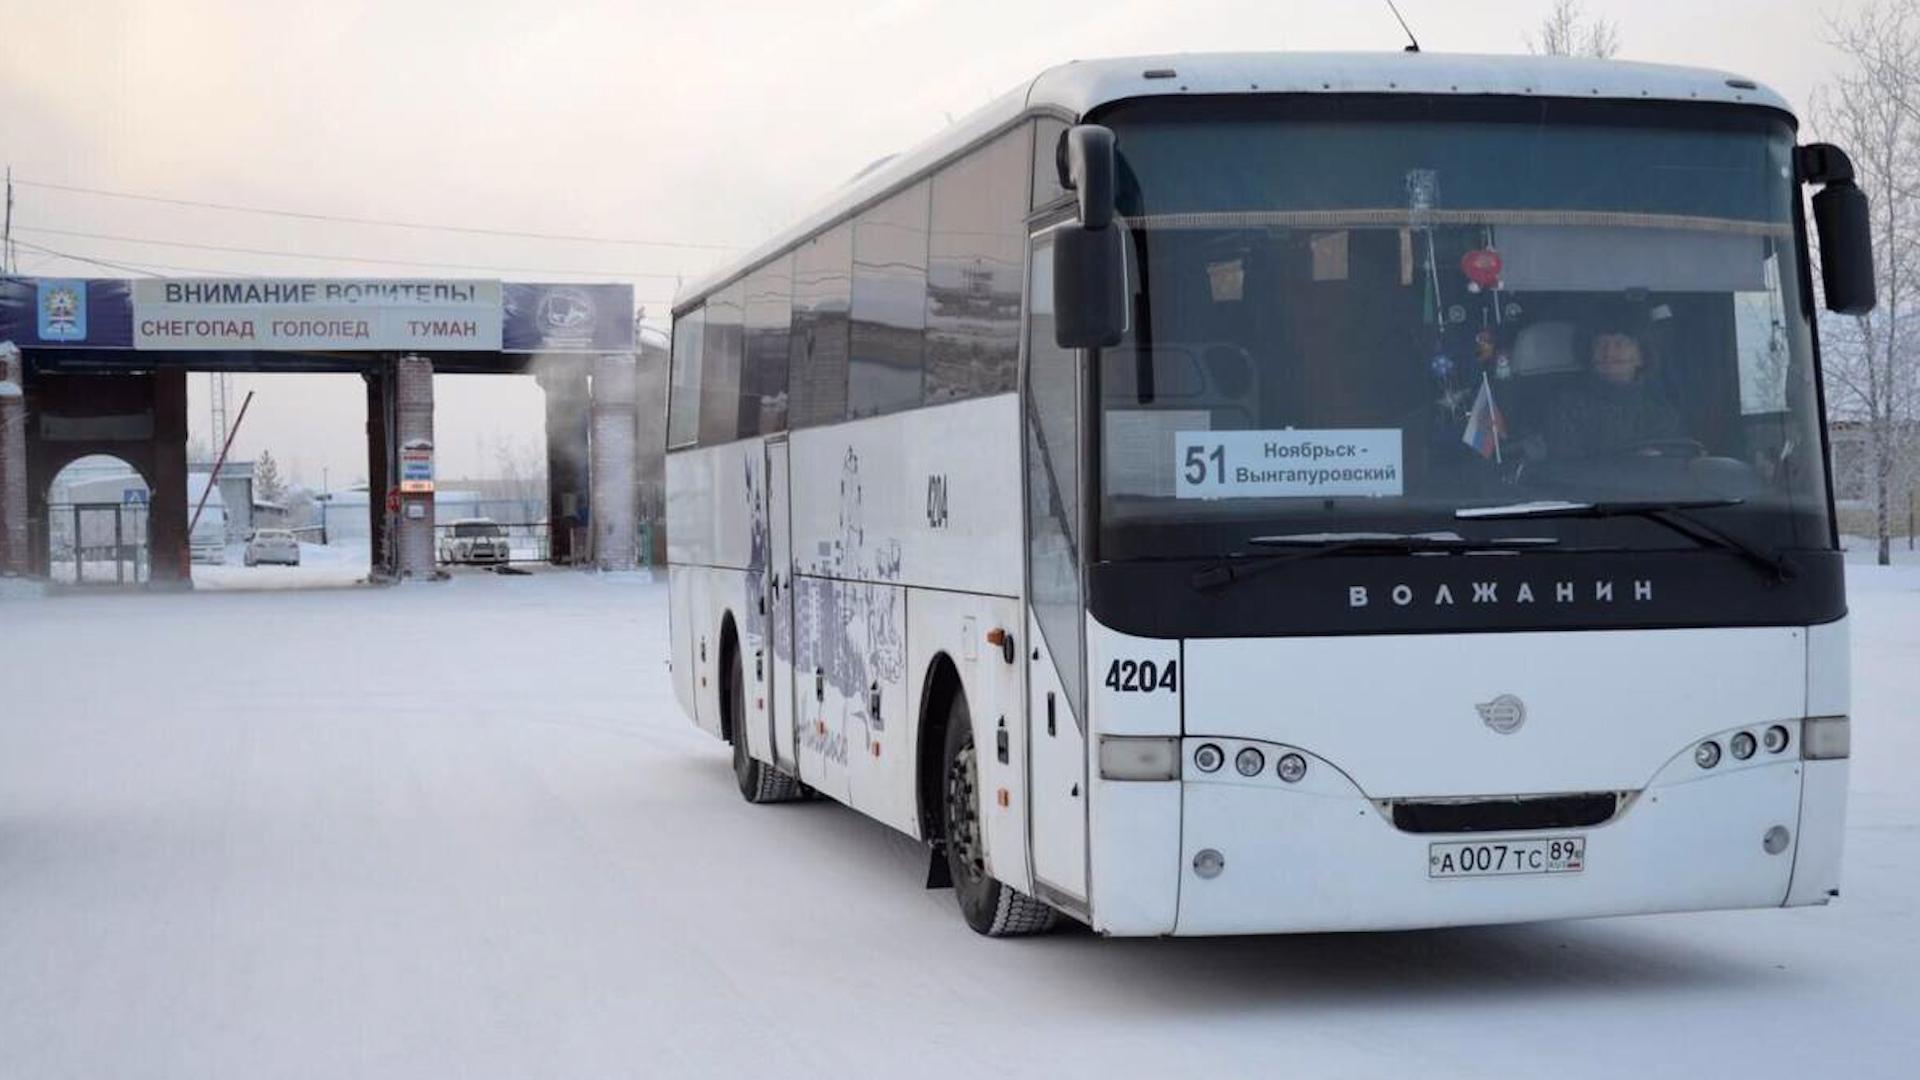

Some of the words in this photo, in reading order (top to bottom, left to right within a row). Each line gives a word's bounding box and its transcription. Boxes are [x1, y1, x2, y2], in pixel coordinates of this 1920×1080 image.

[165, 283, 316, 304] ВНИМАНИЕ
[141, 320, 255, 338] СНЕГОПАД
[272, 320, 370, 338] ГОЛОЛЕД
[409, 321, 477, 337] ТУМАН
[1264, 442, 1356, 460] Ноябрьск
[1184, 444, 1226, 485] 51
[1236, 465, 1396, 485] Вынгапуровский
[926, 474, 948, 529] 4204
[1349, 579, 1653, 607] ВОЛЖАНИН
[1105, 659, 1177, 692] 4204
[1551, 841, 1575, 860] 89
